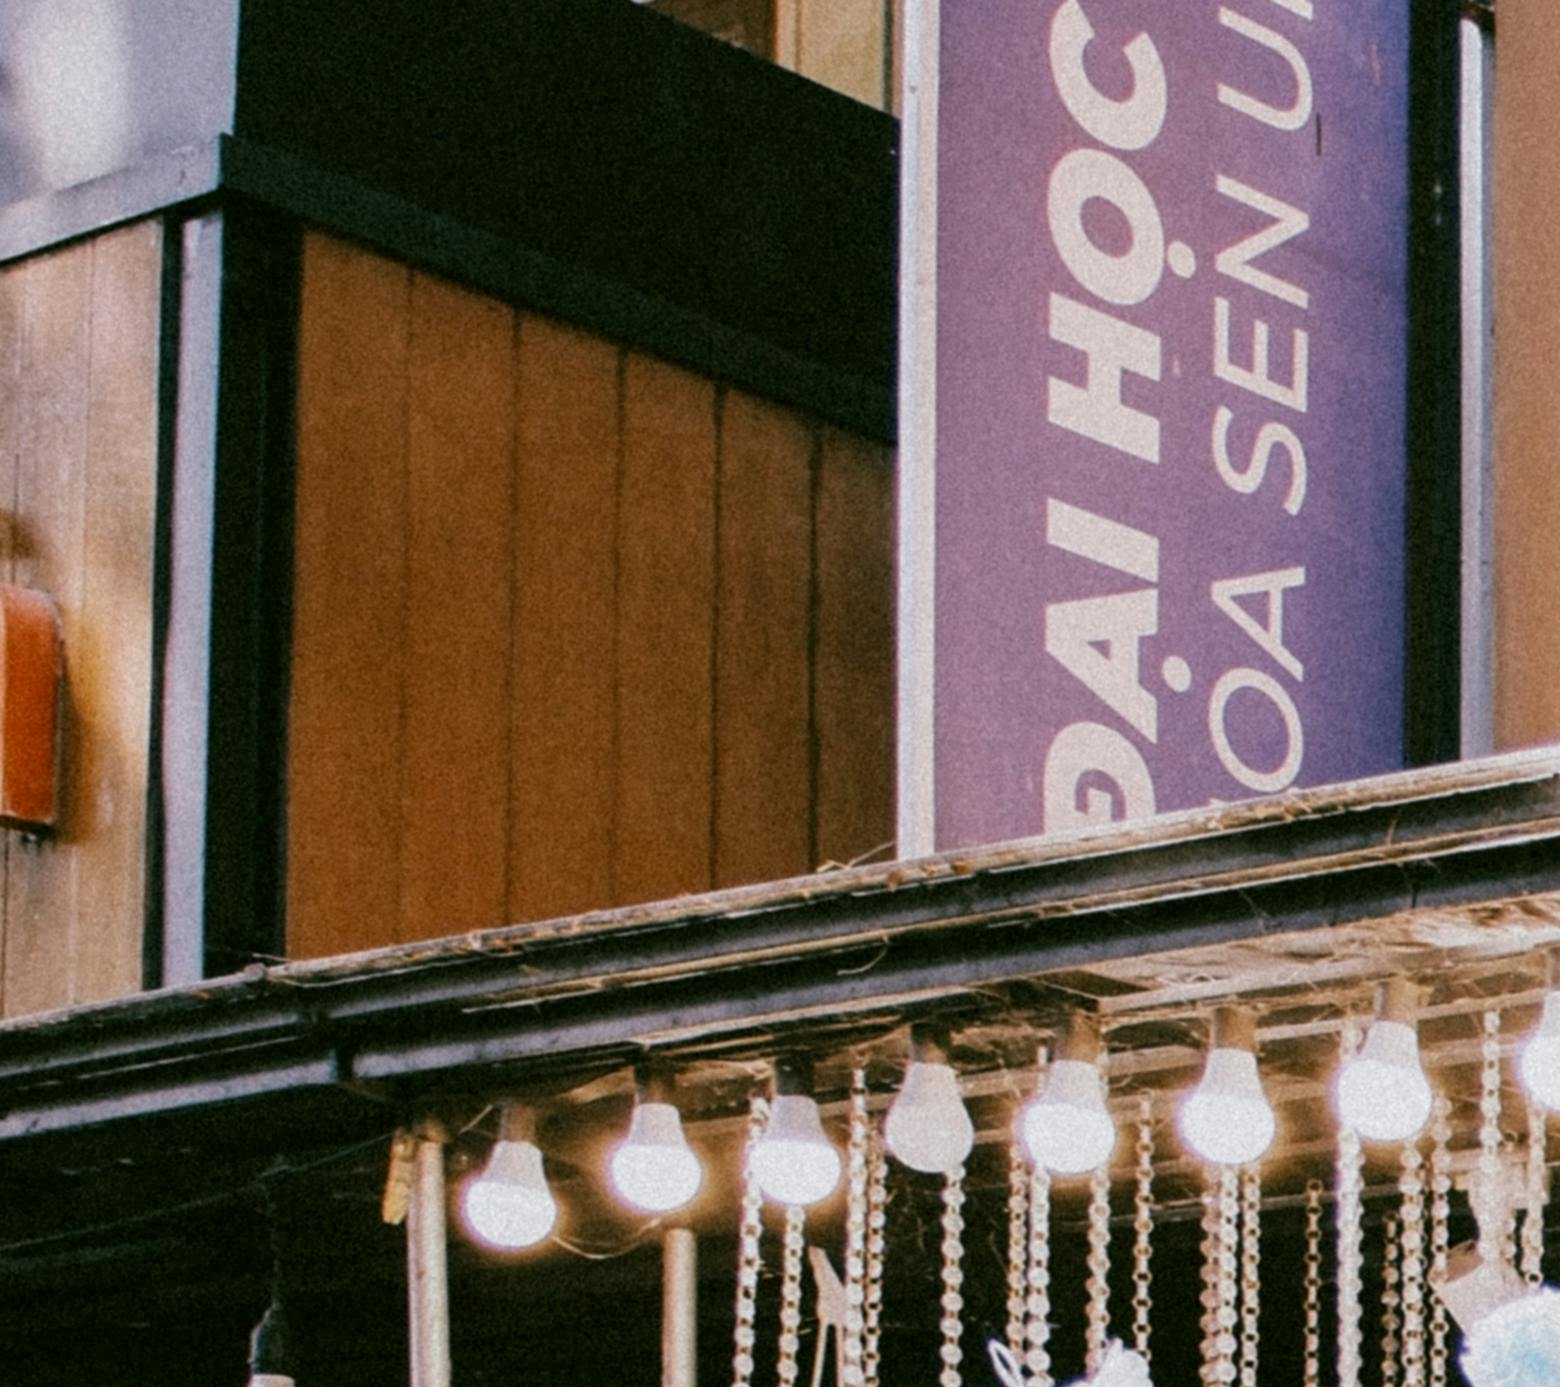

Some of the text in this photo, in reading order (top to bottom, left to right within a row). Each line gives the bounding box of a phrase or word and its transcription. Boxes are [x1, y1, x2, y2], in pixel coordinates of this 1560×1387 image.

[1047, 0, 1198, 464] HỌC
[1208, 0, 1314, 806] OA SEN U
